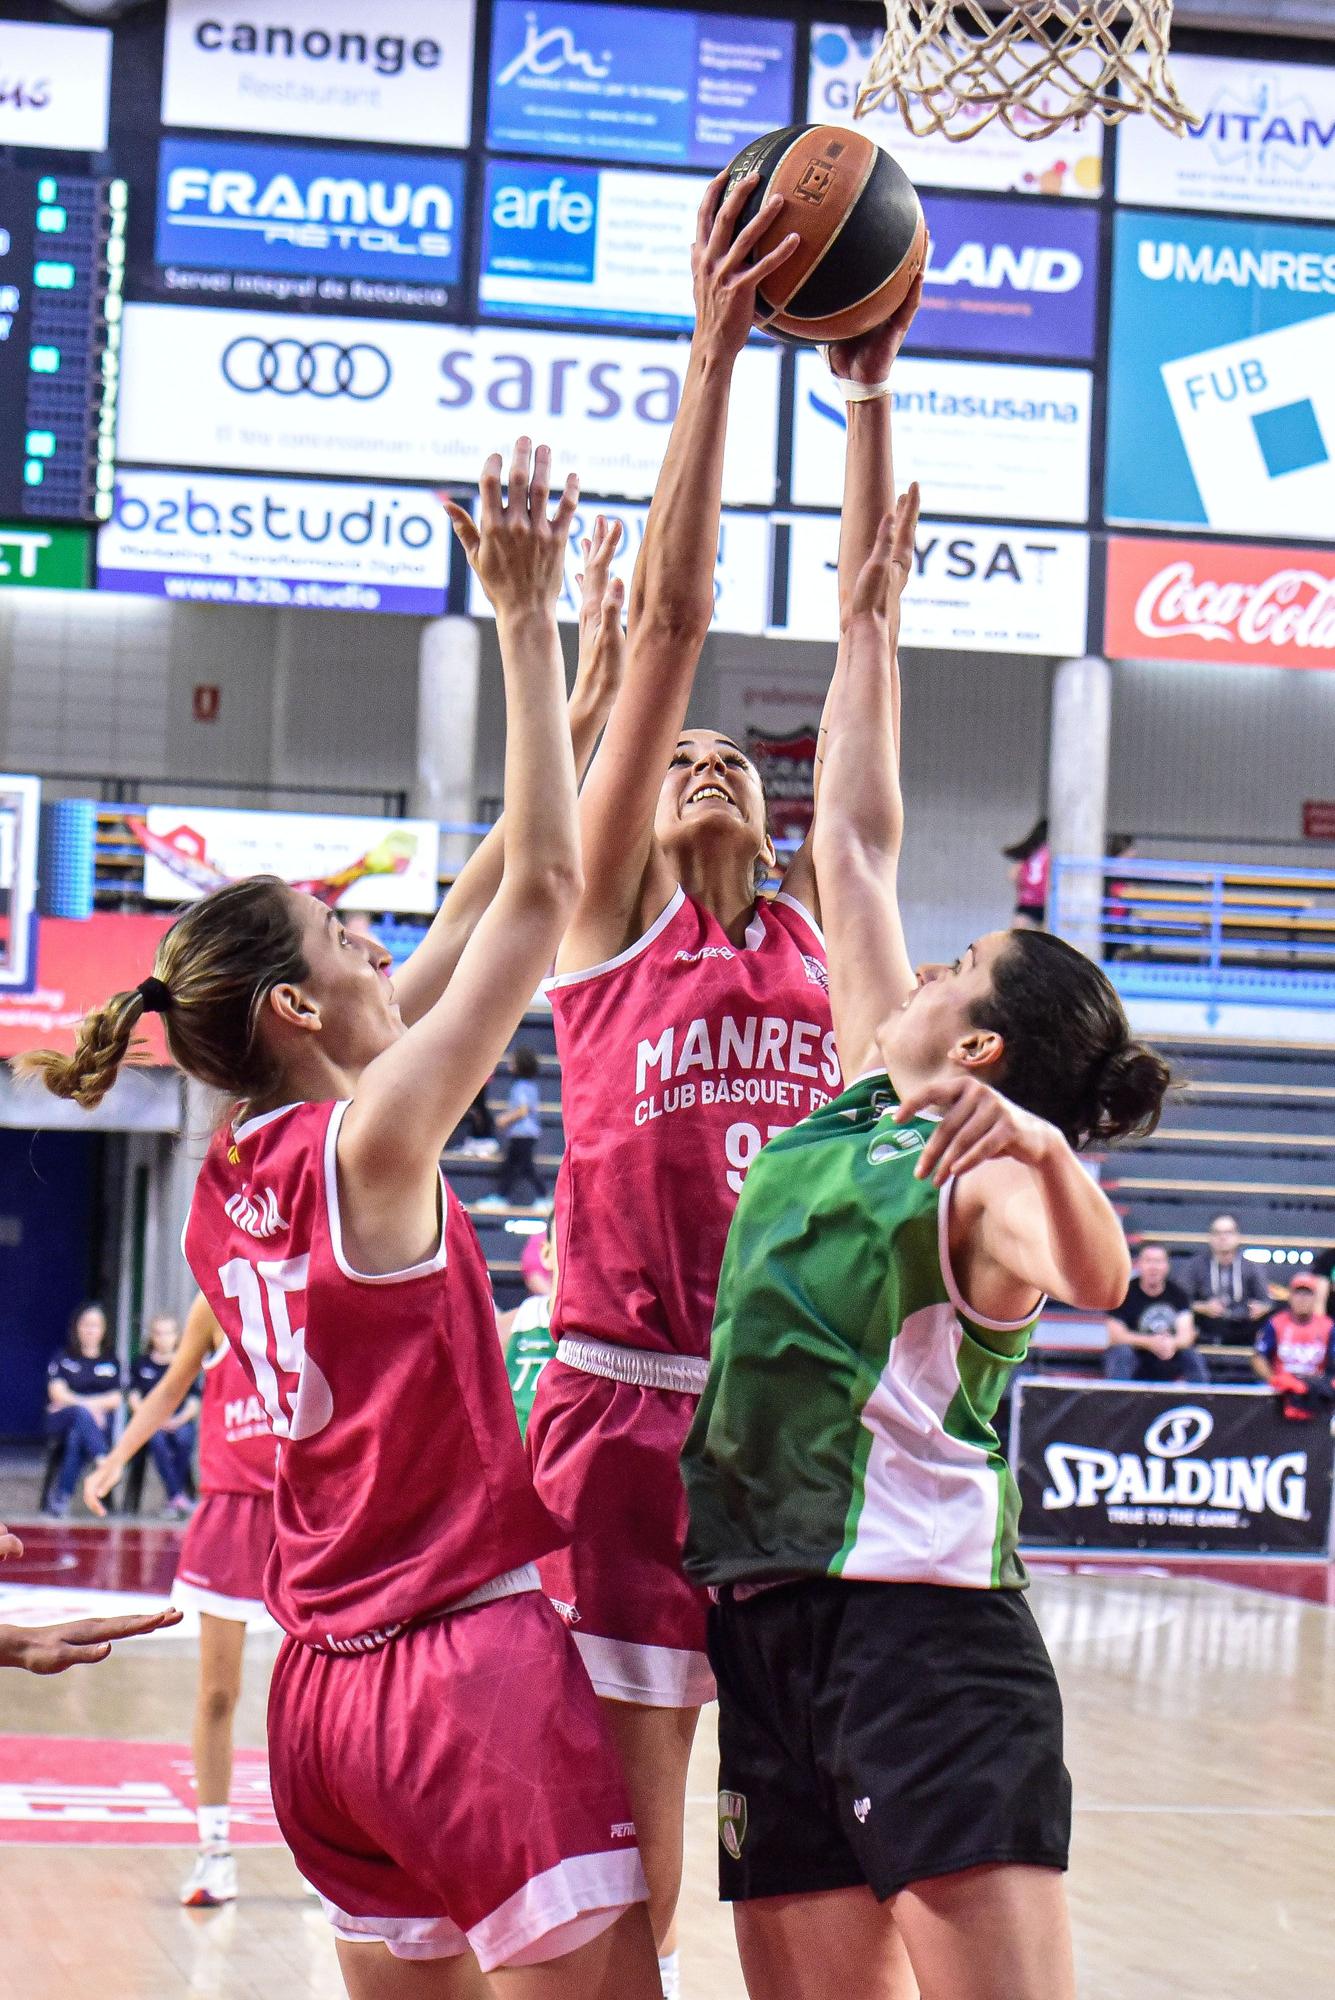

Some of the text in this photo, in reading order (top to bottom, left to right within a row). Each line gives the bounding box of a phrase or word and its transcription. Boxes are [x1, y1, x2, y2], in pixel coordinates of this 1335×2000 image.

[194, 20, 442, 76] canonge
[166, 167, 454, 230] FRAMUN
[492, 176, 594, 236] arfe
[437, 349, 682, 424] sarsa
[1184, 358, 1269, 410] FUB
[634, 1014, 843, 1096] MANRES
[634, 1082, 696, 1127] CLUB
[701, 1073, 804, 1108] BÀSQUET
[1042, 1442, 1311, 1521] SPALDING
[1147, 1505, 1167, 1526] TO
[1168, 1507, 1195, 1527] THE
